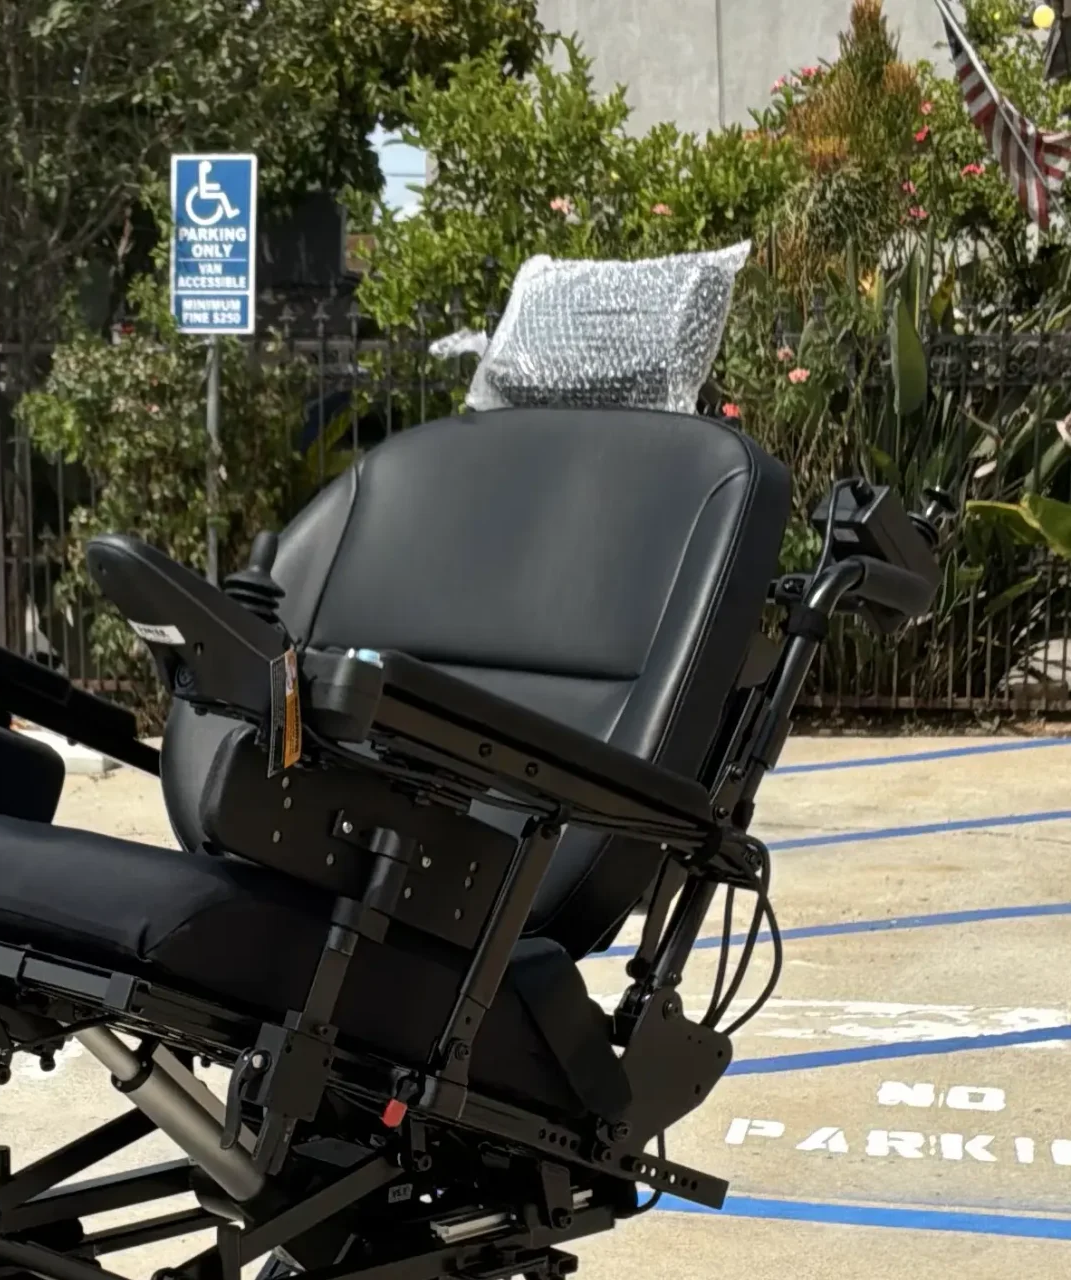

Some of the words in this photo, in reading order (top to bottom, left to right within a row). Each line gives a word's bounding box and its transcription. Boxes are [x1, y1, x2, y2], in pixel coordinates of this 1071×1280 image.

[178, 227, 247, 242] PARKING
[191, 244, 233, 258] ONLY
[198, 263, 223, 275] VAN
[177, 276, 247, 289] ACCESSIBLE
[182, 298, 241, 312] MINIMUM
[182, 312, 210, 325] FINE
[212, 312, 242, 325] $250
[876, 1080, 1007, 1112] NO
